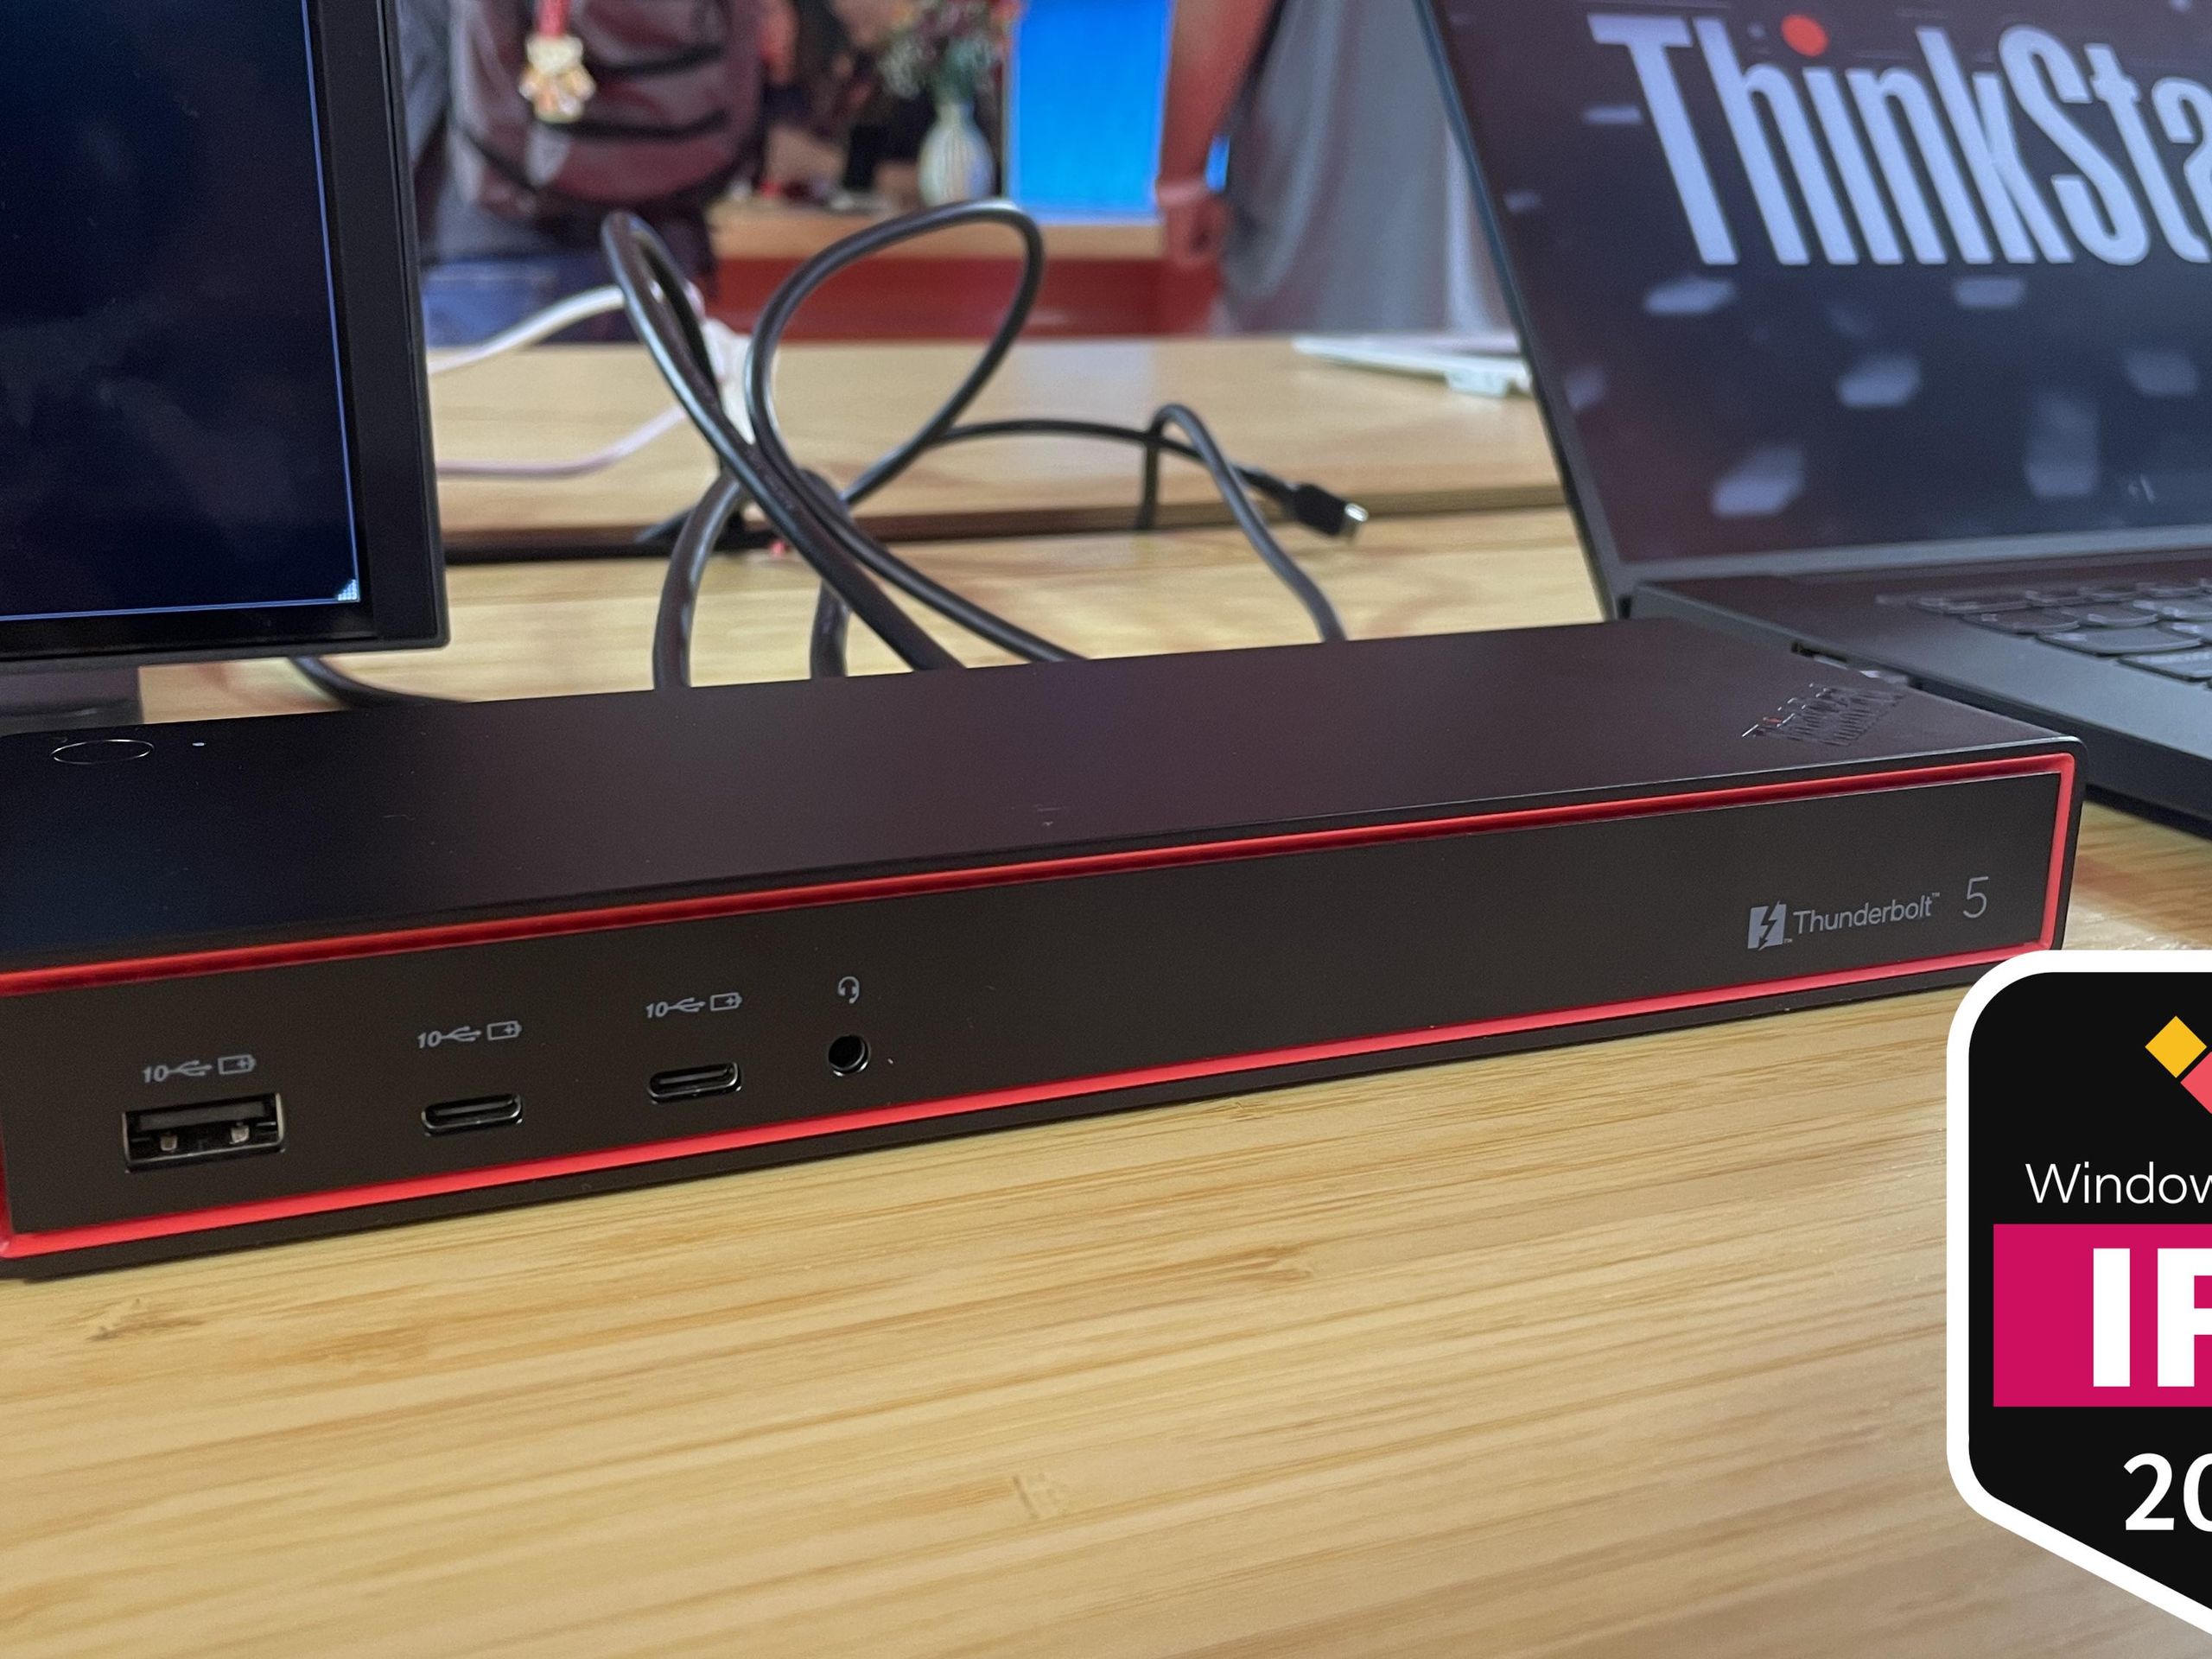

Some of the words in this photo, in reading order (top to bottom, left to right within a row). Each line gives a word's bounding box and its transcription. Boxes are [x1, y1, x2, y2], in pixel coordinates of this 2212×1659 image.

[1962, 876, 1988, 918] 5
[646, 1001, 668, 1019] 10
[417, 1030, 441, 1048] 10
[143, 1064, 168, 1083] 10
